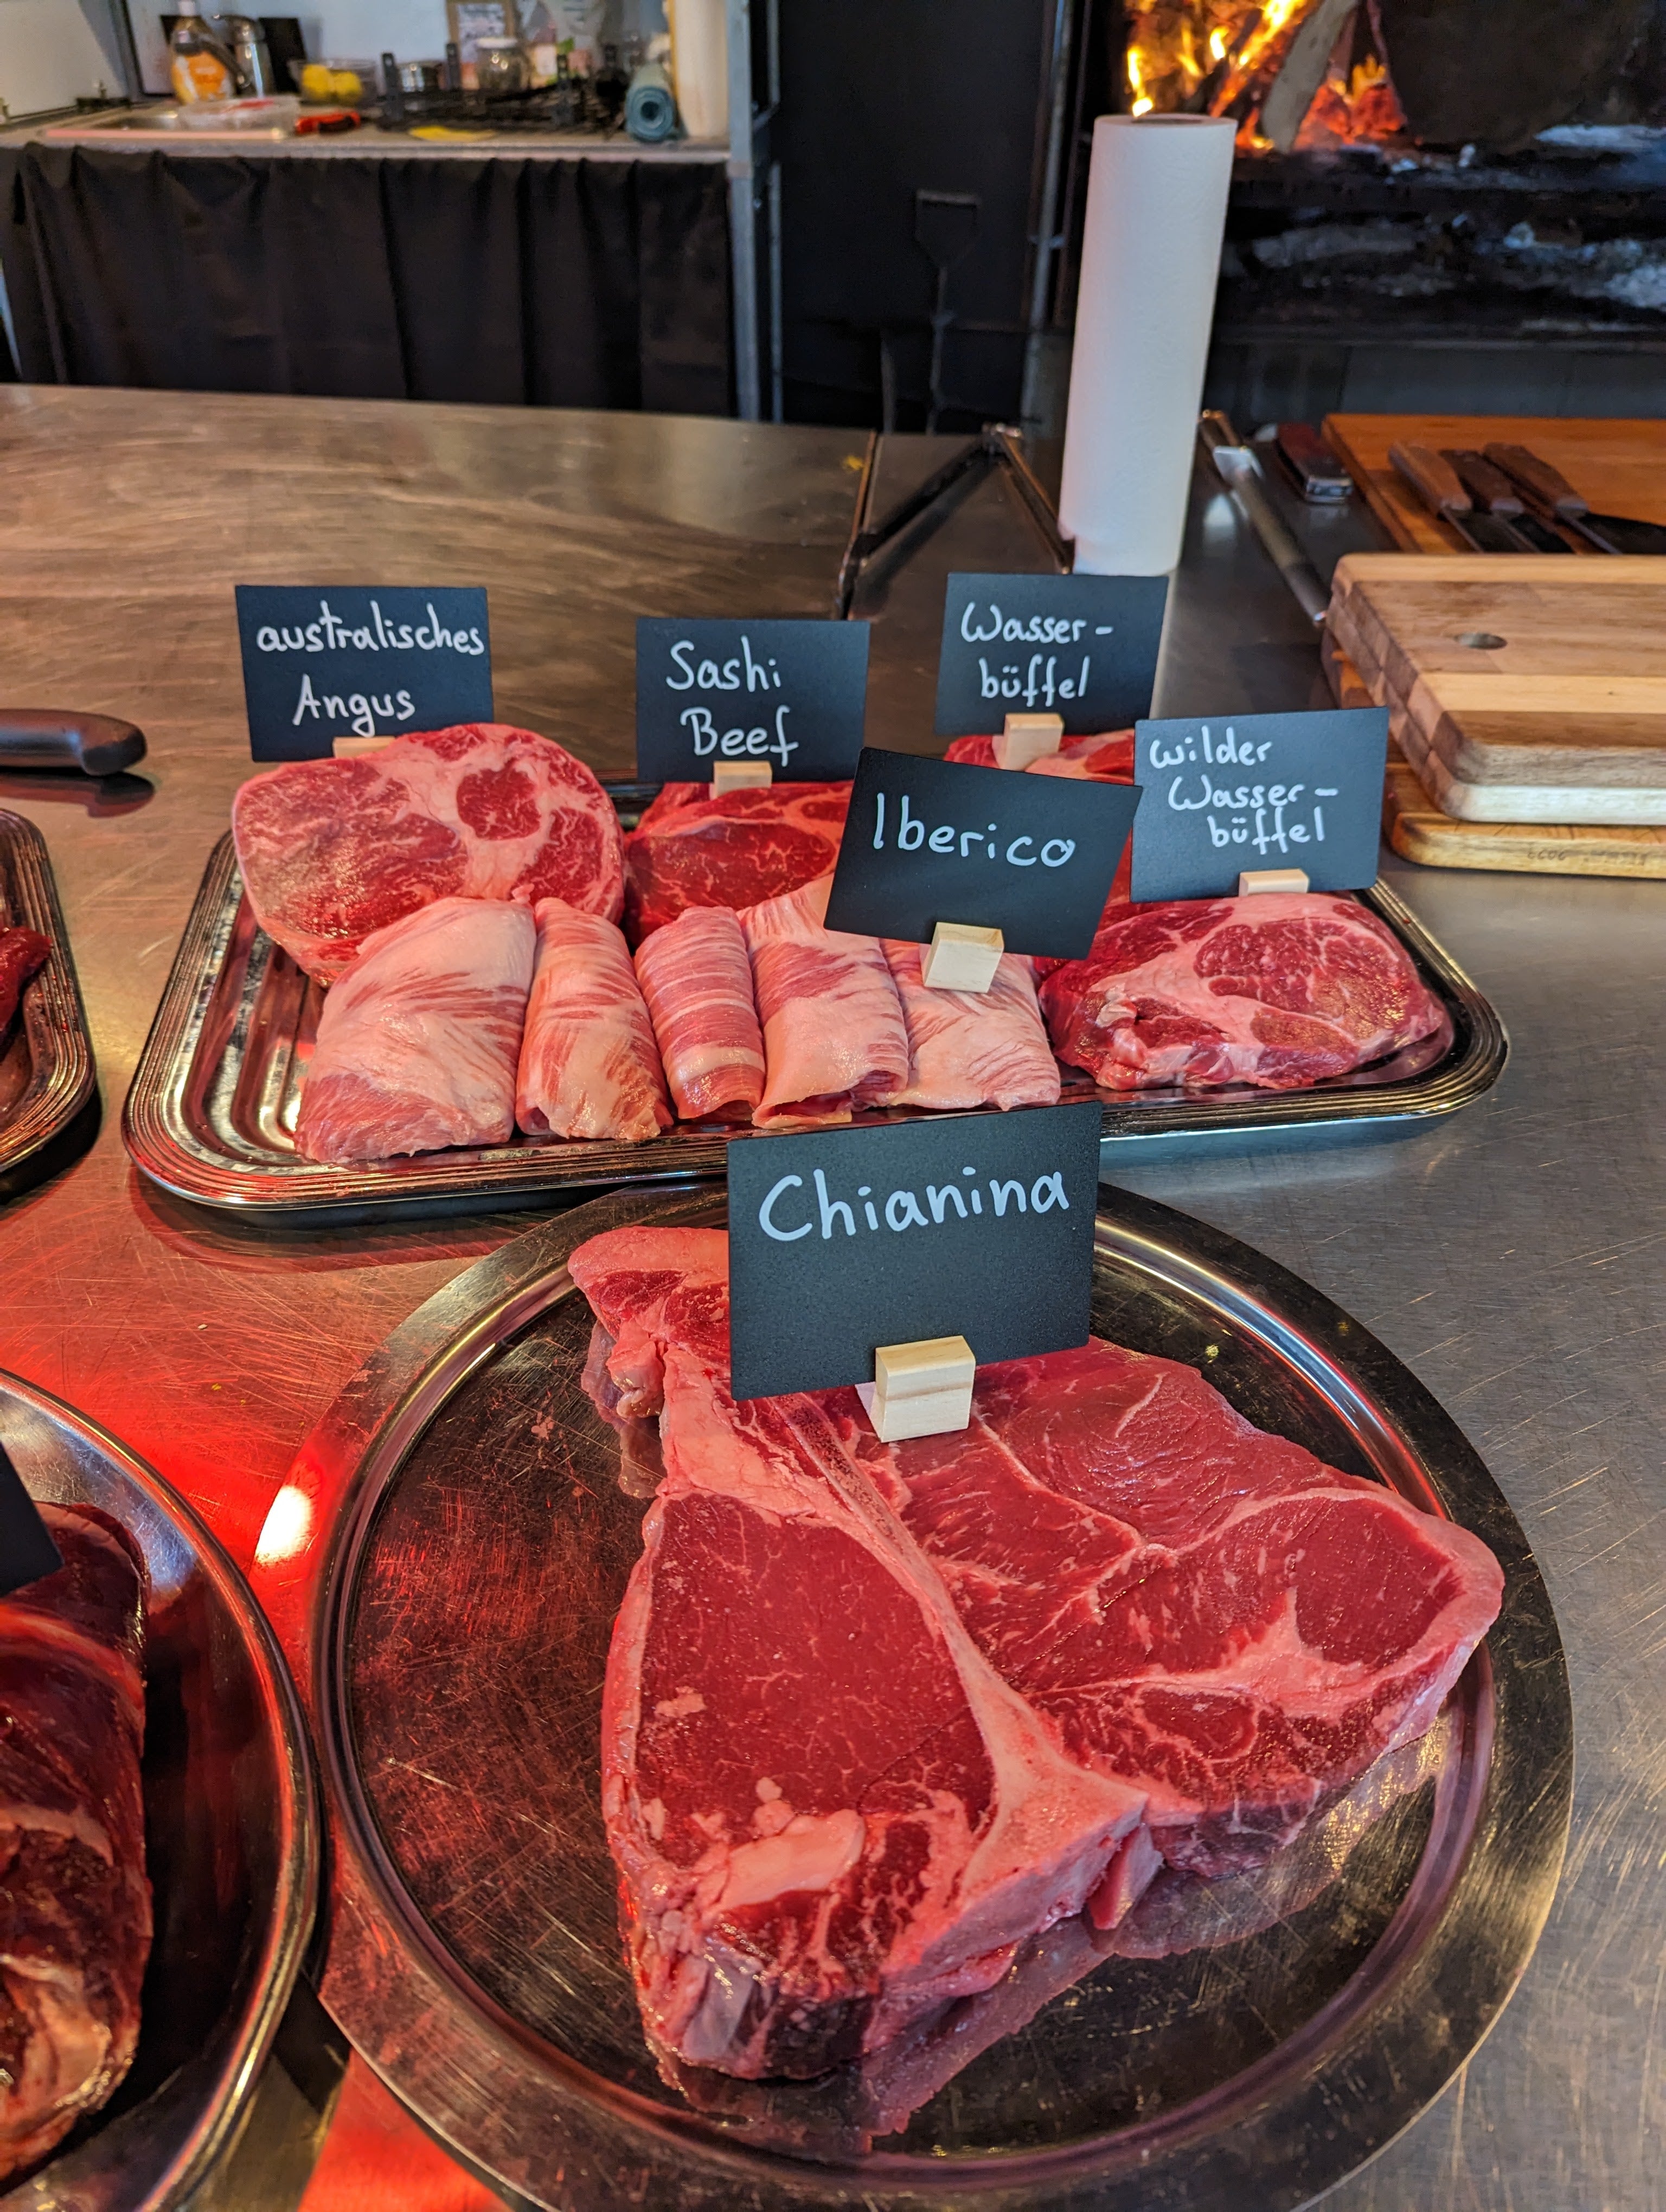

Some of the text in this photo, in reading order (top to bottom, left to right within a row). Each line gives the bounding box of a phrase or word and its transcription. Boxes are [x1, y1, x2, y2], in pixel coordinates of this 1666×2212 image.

[256, 601, 485, 656] australisches
[665, 635, 781, 693] Sashi
[978, 653, 1091, 708] büffel
[292, 673, 416, 738] Angus
[680, 704, 799, 768] Beef
[1149, 725, 1273, 770] wilder
[873, 793, 1077, 867] Iberico
[1207, 807, 1325, 856] büffel
[759, 1166, 1070, 1242] Chianina
